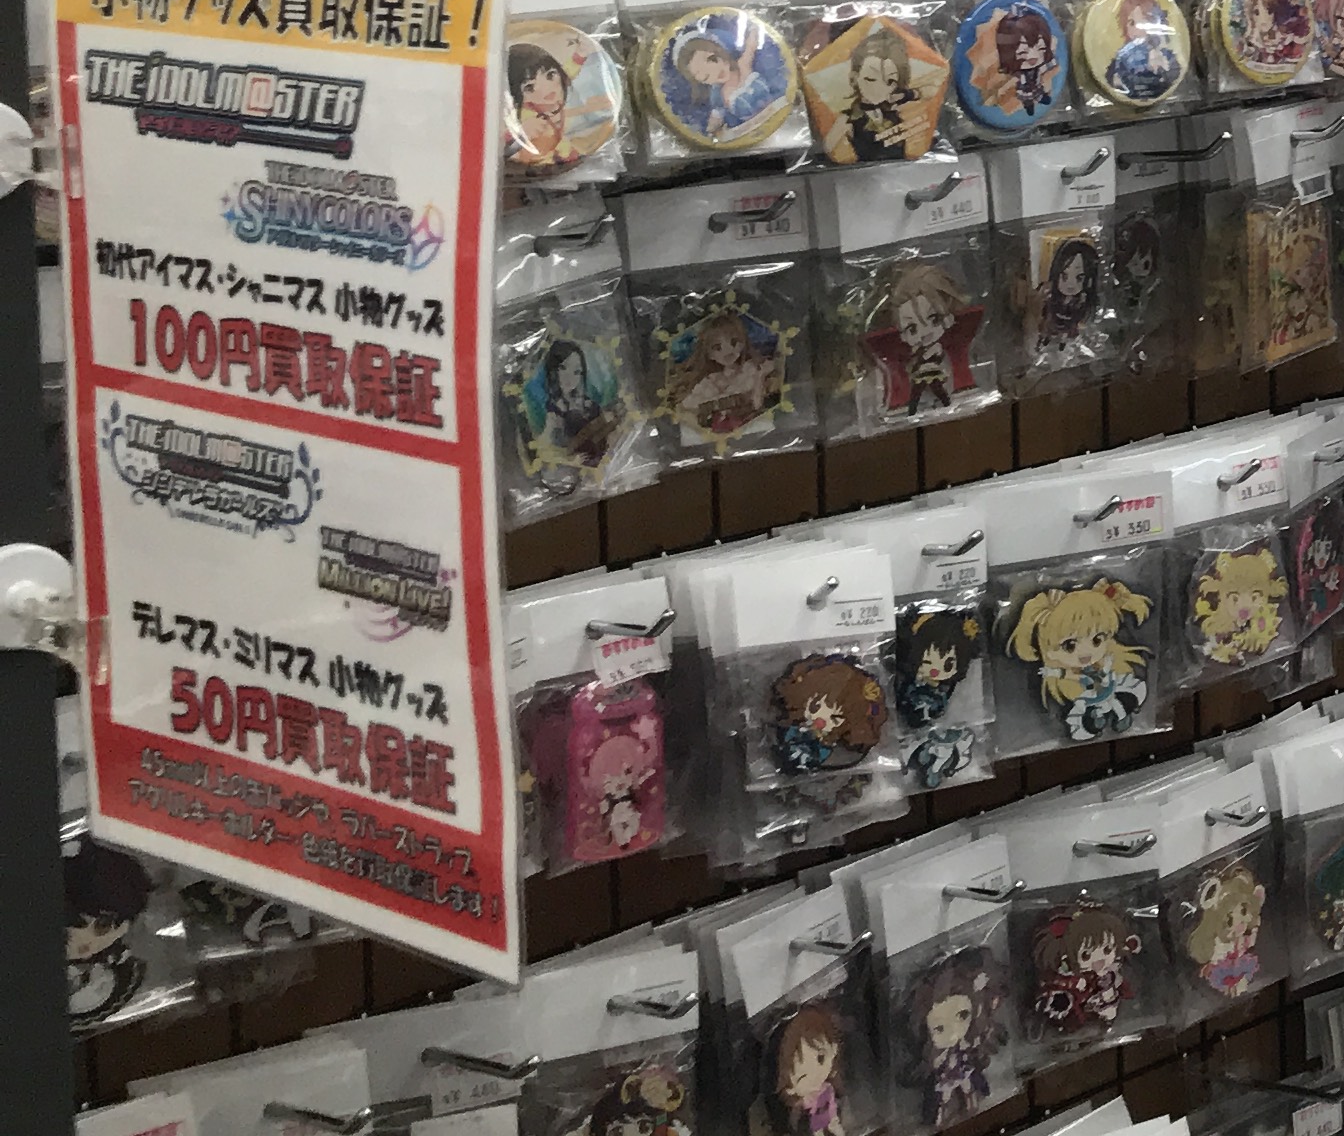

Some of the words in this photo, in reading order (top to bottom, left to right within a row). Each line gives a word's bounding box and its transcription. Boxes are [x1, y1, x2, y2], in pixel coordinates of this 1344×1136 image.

[86, 54, 147, 102] THE
[129, 298, 444, 429] 100円買取保証
[170, 666, 457, 815] 50円買取保証
